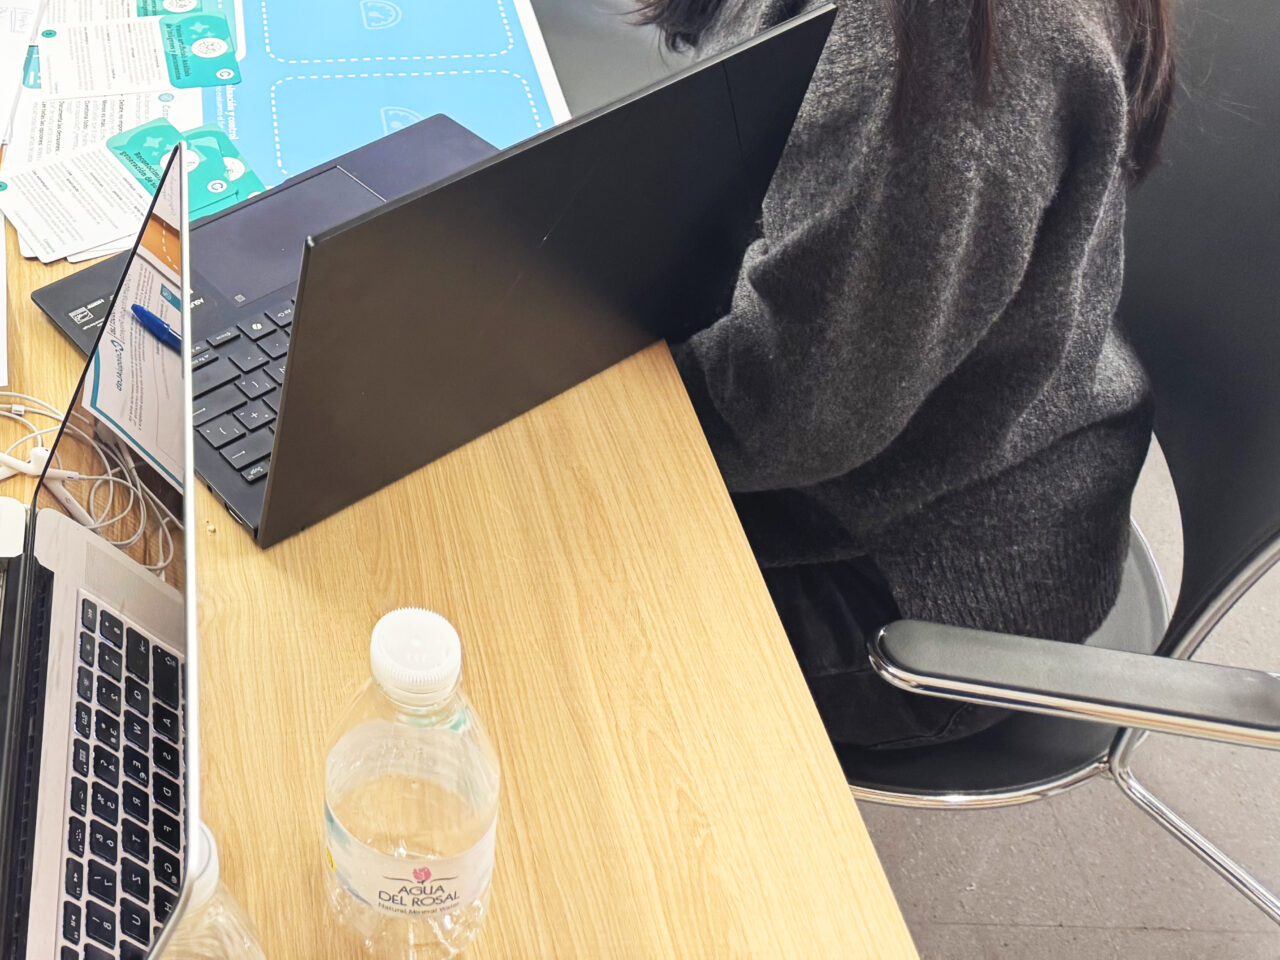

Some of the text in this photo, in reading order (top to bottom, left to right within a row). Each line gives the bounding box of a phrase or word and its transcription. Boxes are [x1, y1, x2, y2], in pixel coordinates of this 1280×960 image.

[119, 151, 148, 177] generación
[398, 885, 445, 896] AGUA
[378, 890, 460, 907] DEL ROSAL
[378, 902, 407, 914] Natural
